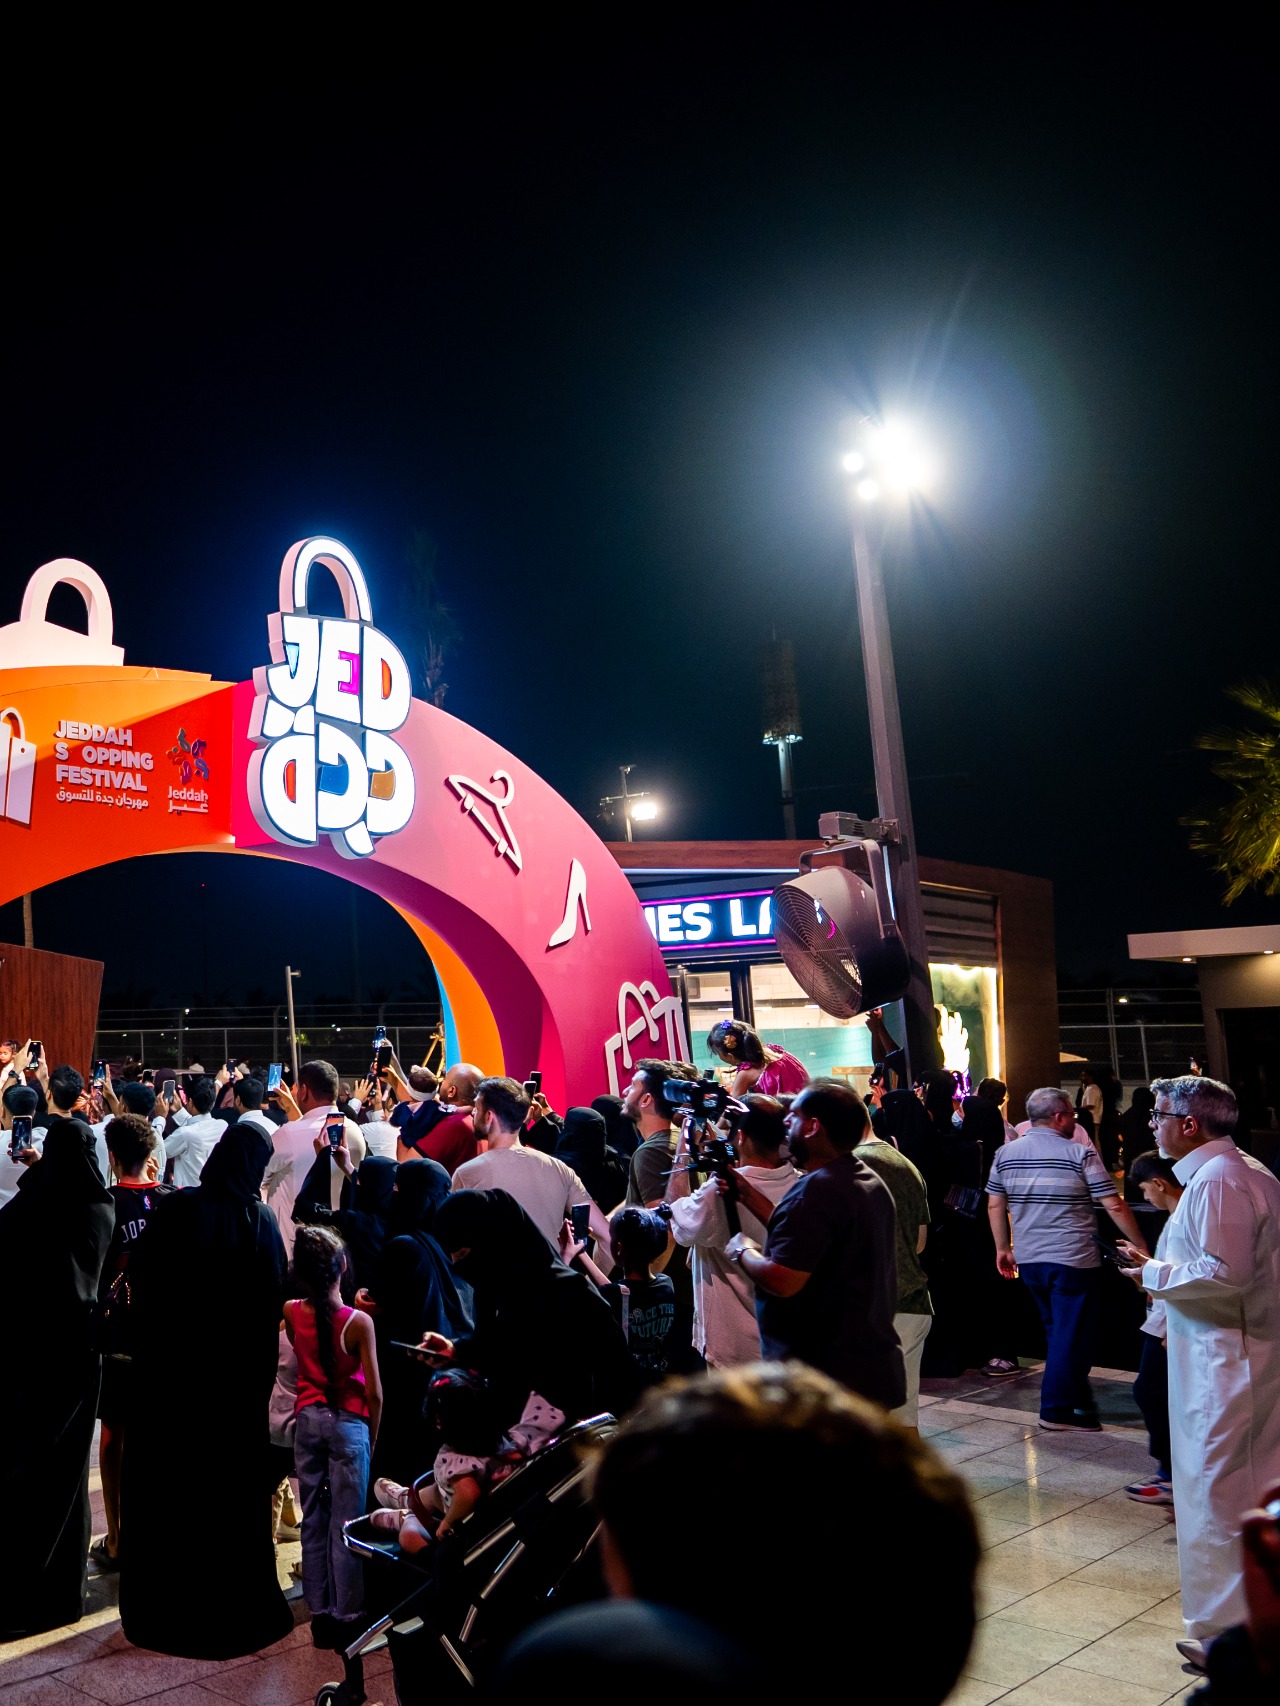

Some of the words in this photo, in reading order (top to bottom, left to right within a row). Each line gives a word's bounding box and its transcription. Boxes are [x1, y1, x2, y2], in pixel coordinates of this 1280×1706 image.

[266, 614, 411, 732] JED
[56, 720, 133, 747] JEDDAH
[56, 764, 147, 792] FESTIVAL
[56, 787, 95, 803] للتسوق
[96, 792, 115, 807] جدة
[115, 793, 149, 810] مهرجان
[167, 785, 209, 802] Jeddah
